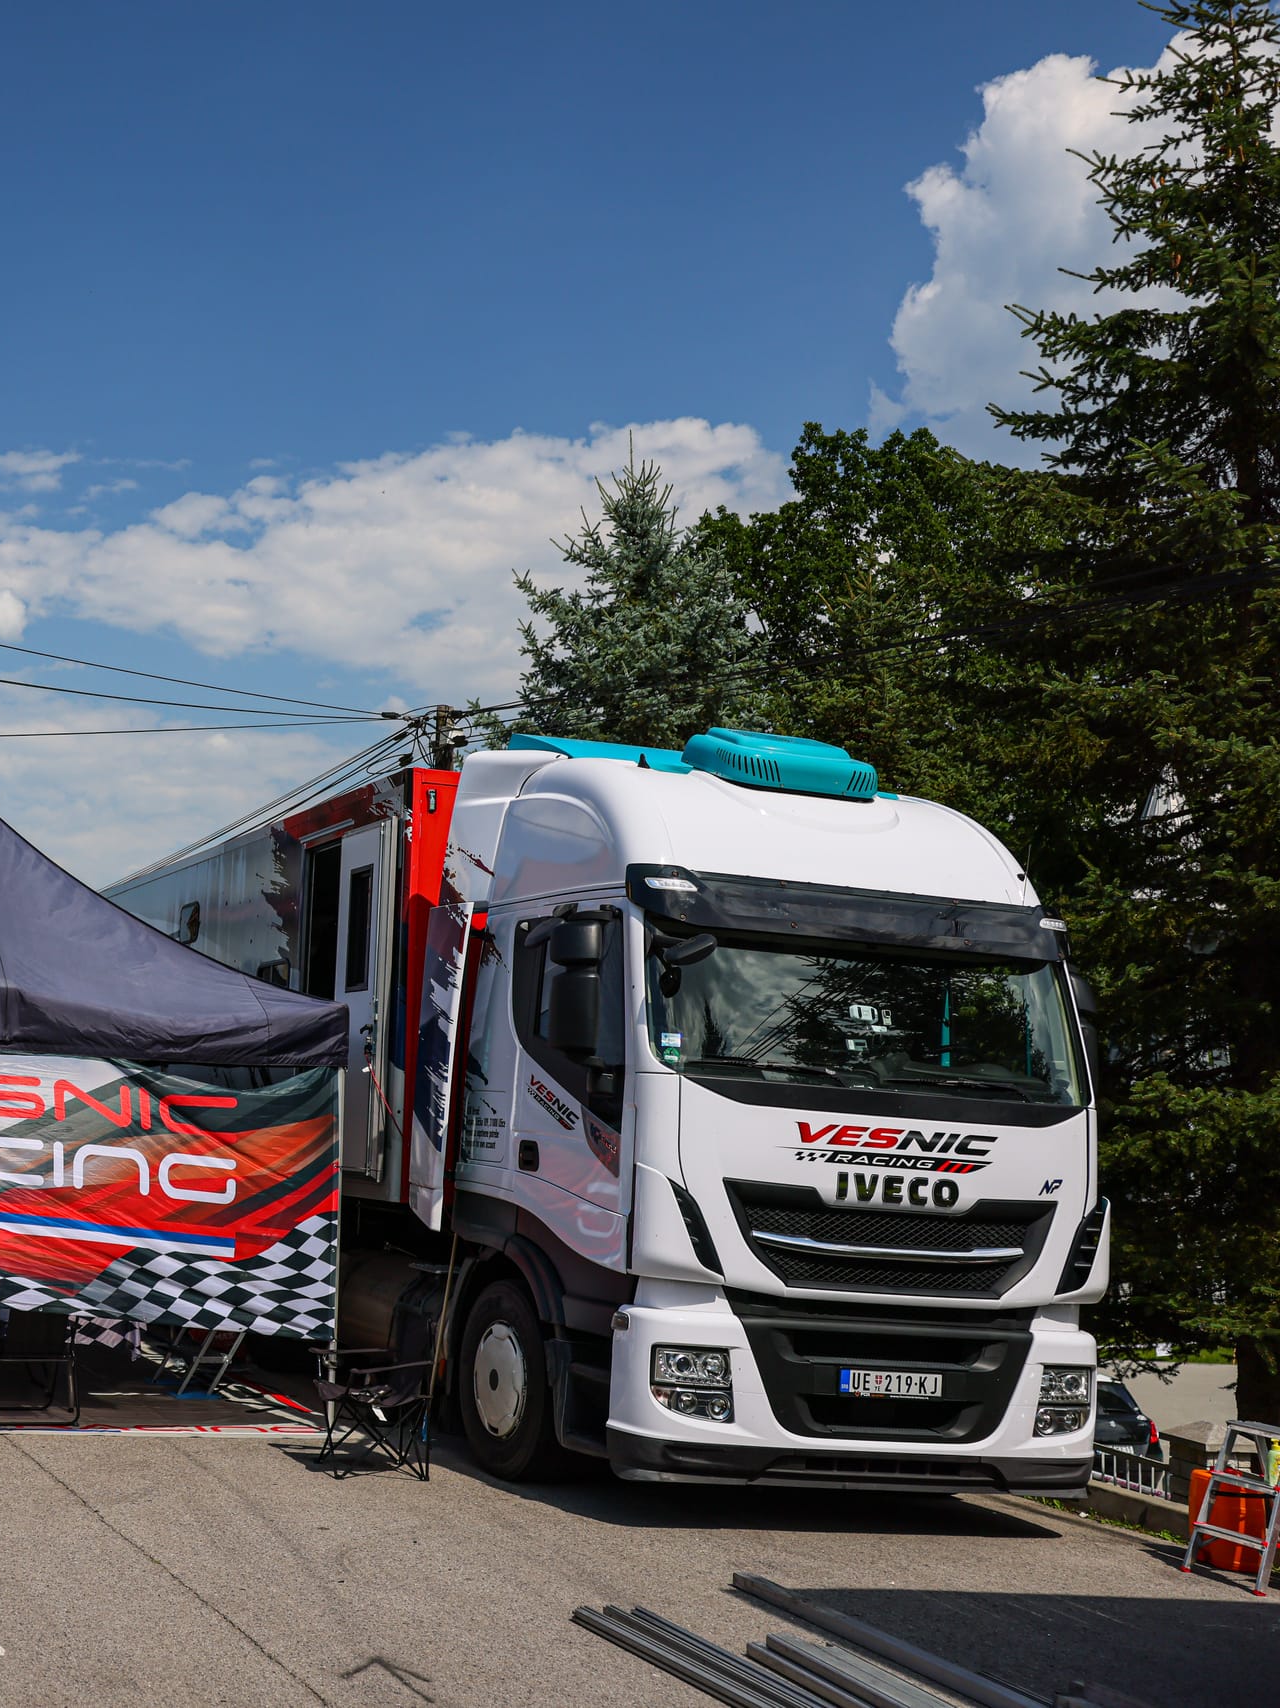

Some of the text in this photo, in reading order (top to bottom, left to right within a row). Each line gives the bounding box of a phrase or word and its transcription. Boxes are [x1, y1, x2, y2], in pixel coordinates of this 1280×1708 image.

[529, 1073, 580, 1125] VESNIC
[795, 1121, 998, 1156] VESNIC
[834, 1153, 934, 1169] RACING
[836, 1171, 960, 1208] IVECO
[852, 1372, 871, 1391] UE
